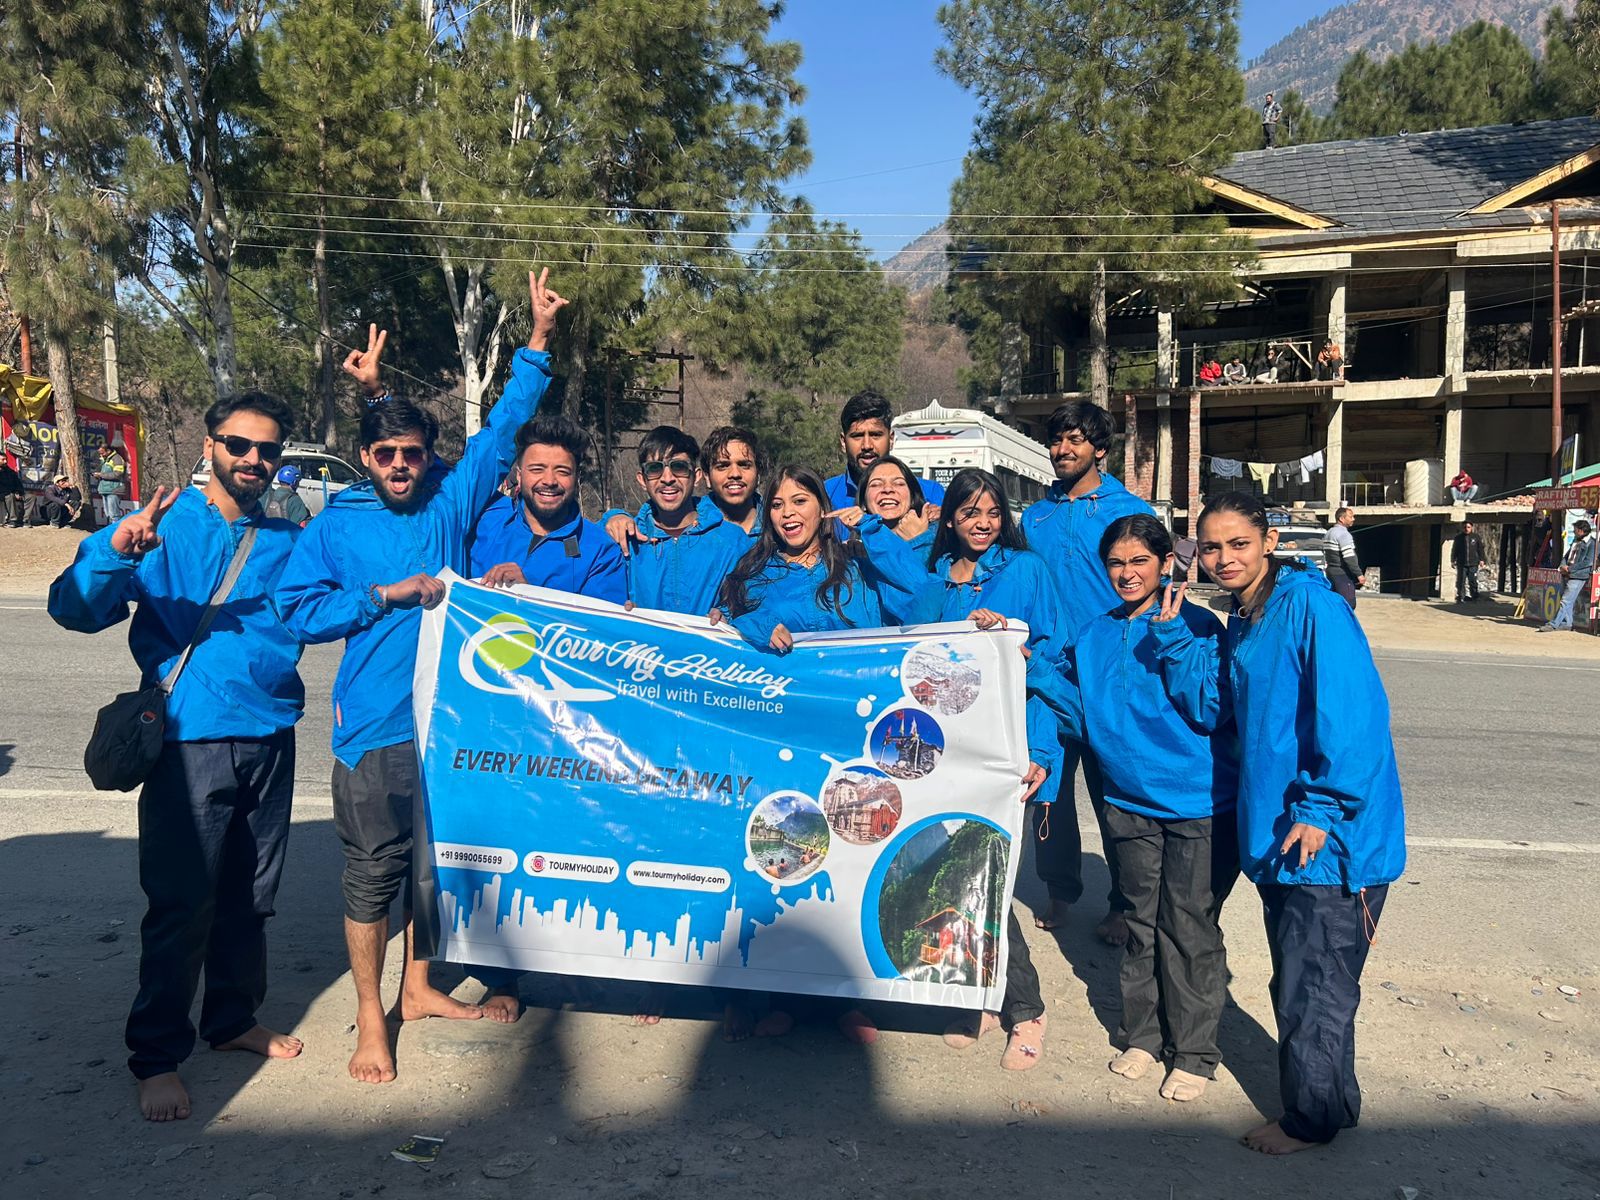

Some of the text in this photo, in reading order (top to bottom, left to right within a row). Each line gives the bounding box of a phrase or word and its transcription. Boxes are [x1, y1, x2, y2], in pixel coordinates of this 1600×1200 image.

[1539, 489, 1576, 500] RAFTING
[540, 623, 793, 698] Tour My Holiday
[615, 678, 785, 714] Travel with Excellence
[452, 748, 523, 774] EVERY
[526, 755, 628, 784] WEEKEND
[549, 861, 614, 875] TOURMYHOLIDAY
[633, 869, 725, 885] www.tourmyholiday.com
